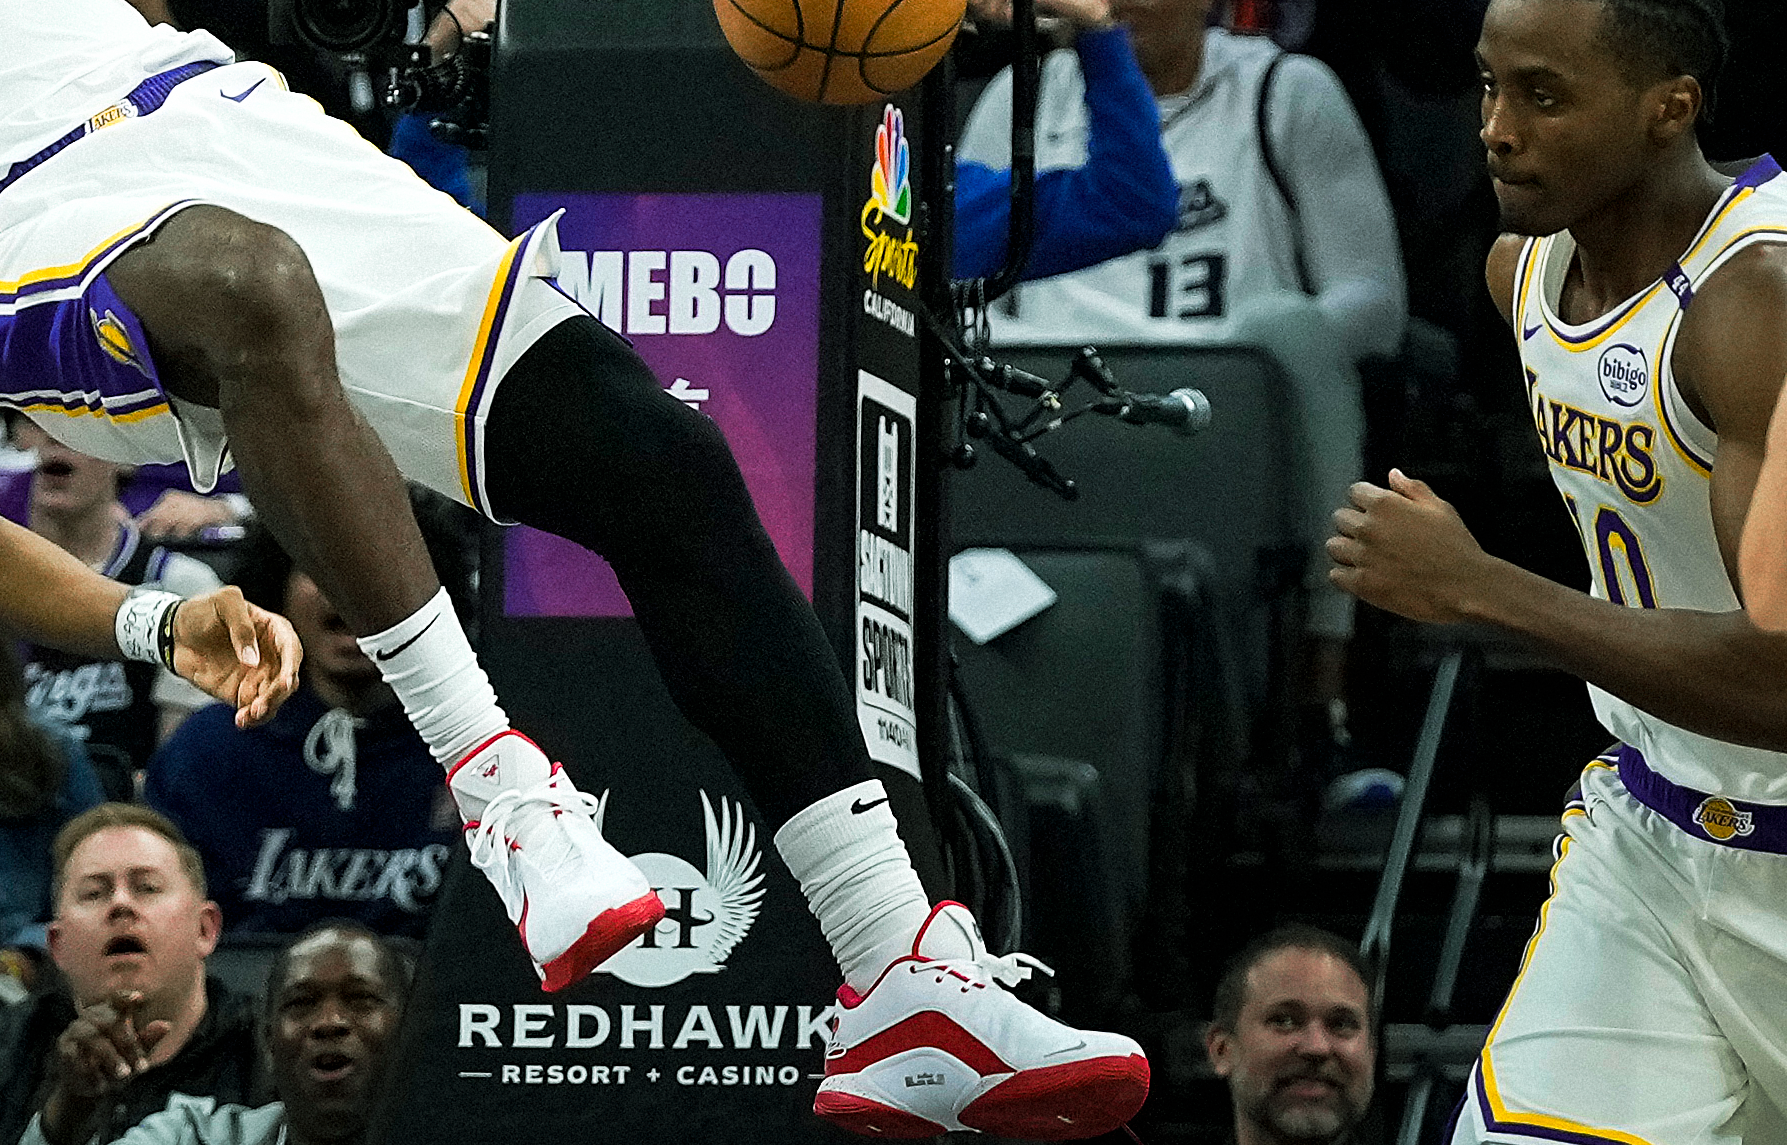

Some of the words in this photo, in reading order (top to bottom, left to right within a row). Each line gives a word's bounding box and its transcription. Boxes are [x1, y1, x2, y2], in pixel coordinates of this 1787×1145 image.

[860, 196, 920, 291] Sports
[1148, 254, 1225, 318] 13
[1603, 357, 1645, 391] bibigo
[1526, 366, 1663, 506] AKERS
[1697, 803, 1753, 835] LAKERS
[236, 823, 452, 913] LAKERS
[457, 1003, 836, 1050] REDHAWK
[501, 1063, 631, 1086] RESORT
[675, 1064, 801, 1087] CASINO
